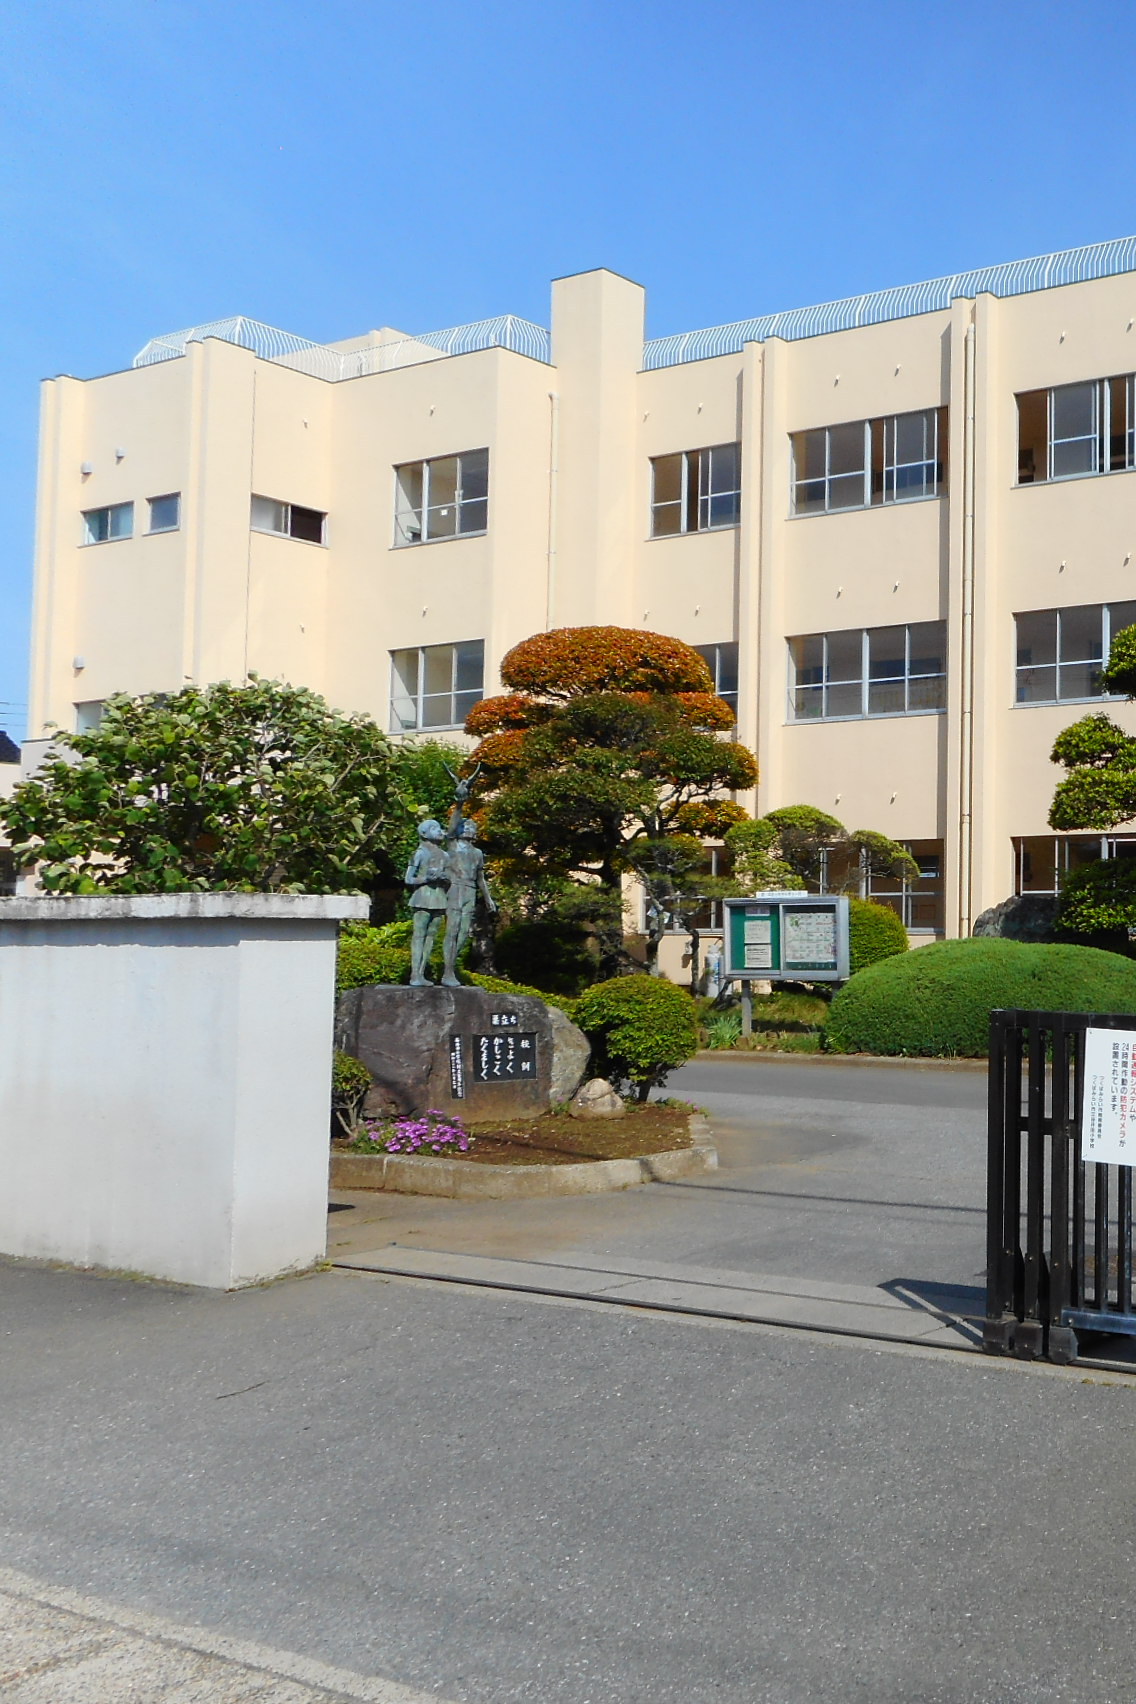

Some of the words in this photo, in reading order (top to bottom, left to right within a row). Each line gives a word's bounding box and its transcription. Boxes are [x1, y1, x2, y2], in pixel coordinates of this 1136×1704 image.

[480, 1036, 489, 1080] たくましく
[493, 1036, 503, 1076] かしこく
